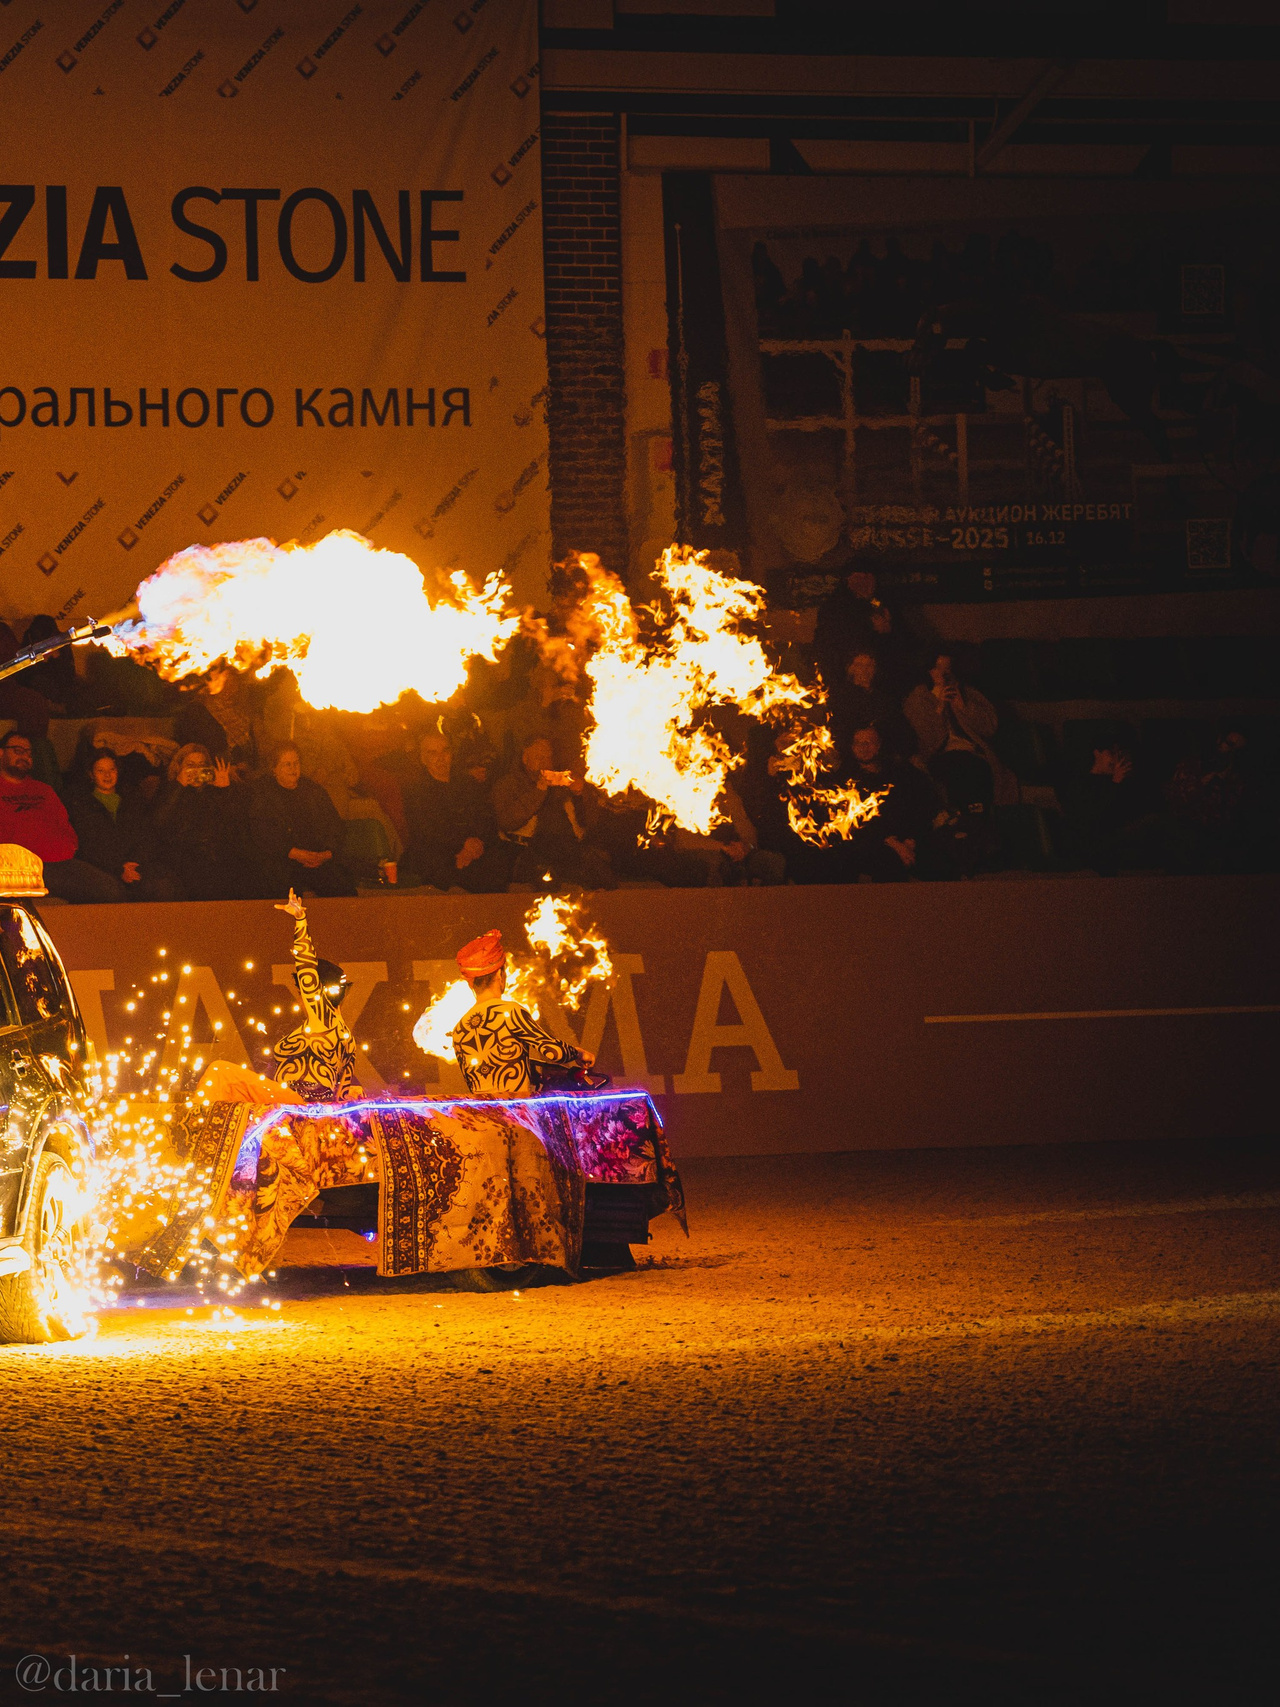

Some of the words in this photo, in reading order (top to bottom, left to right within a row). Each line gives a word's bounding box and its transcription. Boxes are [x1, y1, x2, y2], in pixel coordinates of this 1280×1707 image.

[21, 18, 45, 45] STONE
[73, 19, 105, 53] VENEZIA
[314, 26, 345, 59] VENEZIA
[341, 2, 364, 29] STONE
[392, 3, 423, 37] VENEZIA
[182, 49, 206, 76] STONE
[234, 49, 267, 82] VENEZIA
[262, 25, 285, 51] STONE
[476, 45, 500, 72] STONE
[400, 69, 423, 94] STONE
[508, 134, 539, 167] VENEZIA
[169, 186, 467, 283] STONE
[489, 222, 519, 255] VENEZIA
[515, 198, 538, 224] STONE
[496, 286, 519, 313] STONE
[296, 386, 472, 428] камня
[135, 496, 167, 531] VENEZIA
[163, 473, 187, 499] STONE
[215, 471, 248, 505] VENEZIA
[54, 520, 87, 555] VENEZIA
[83, 497, 106, 524] STONE
[1041, 503, 1132, 521] ЖЕРЕБЯТ
[1, 522, 25, 549] STONE
[1026, 530, 1066, 546] 16.12
